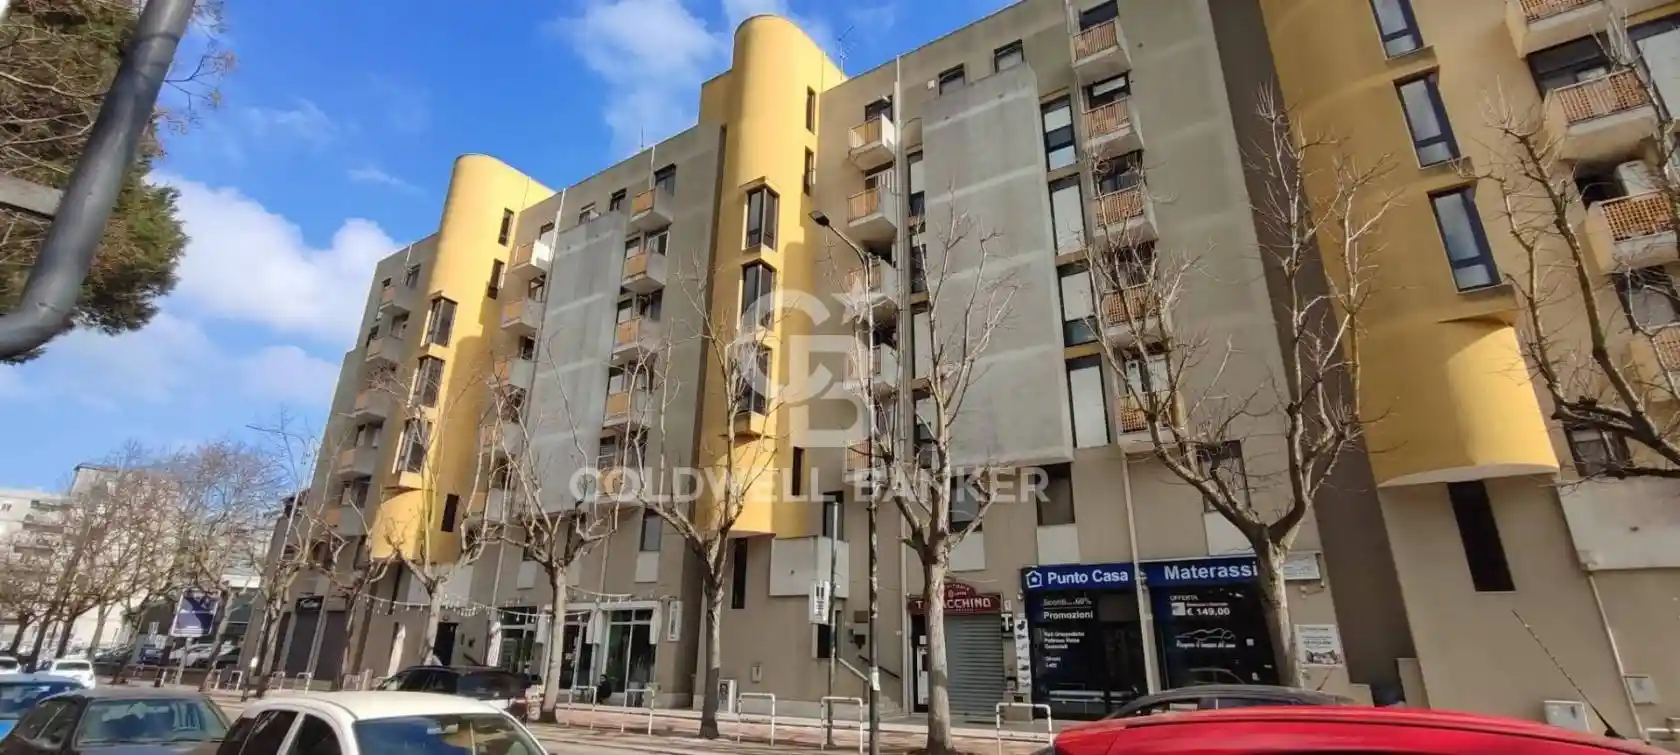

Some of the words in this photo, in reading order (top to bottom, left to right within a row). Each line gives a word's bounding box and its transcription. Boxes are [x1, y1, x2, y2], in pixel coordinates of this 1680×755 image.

[1047, 571, 1089, 585] Punto
[1092, 569, 1129, 583] Casa
[1164, 561, 1259, 581] Materassi
[1043, 610, 1094, 619] Promozioni
[1196, 607, 1231, 616] 149,00
